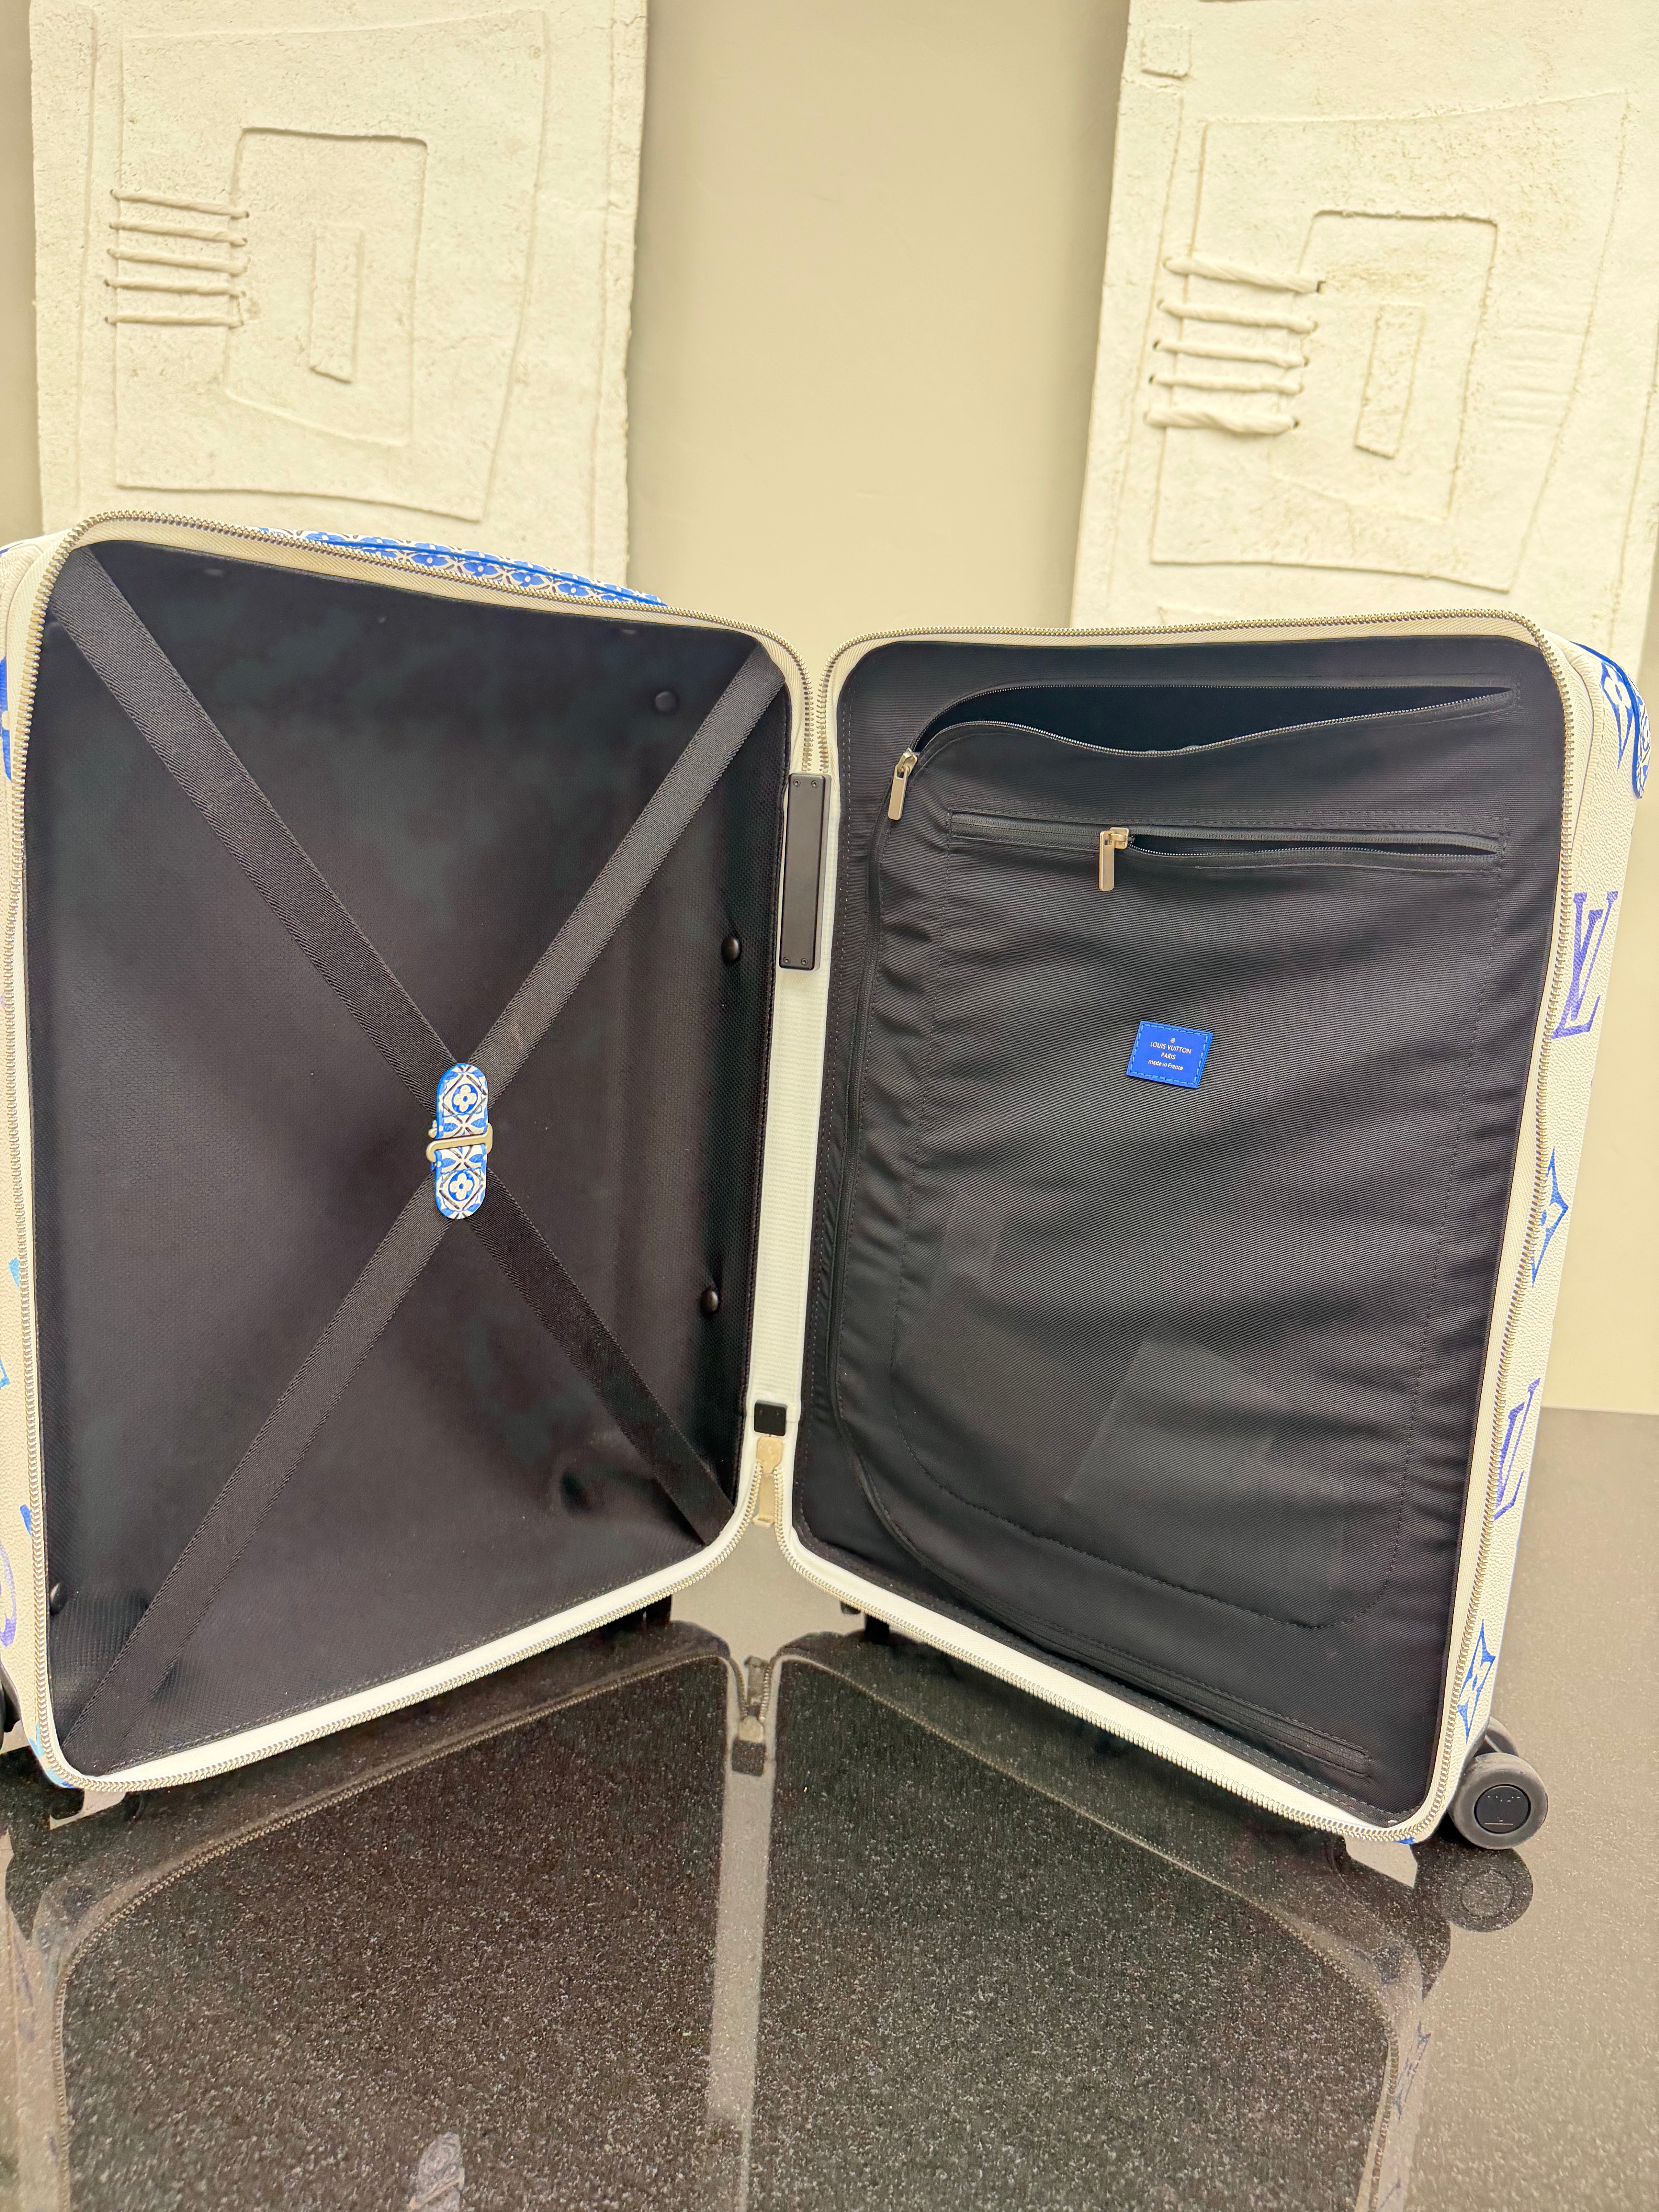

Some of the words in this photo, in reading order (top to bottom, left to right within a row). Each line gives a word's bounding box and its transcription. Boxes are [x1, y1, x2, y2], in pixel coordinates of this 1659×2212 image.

[1150, 1041, 1166, 1049] LOUIS
[1167, 1044, 1192, 1054] VUITTON
[1168, 1063, 1183, 1071] France
